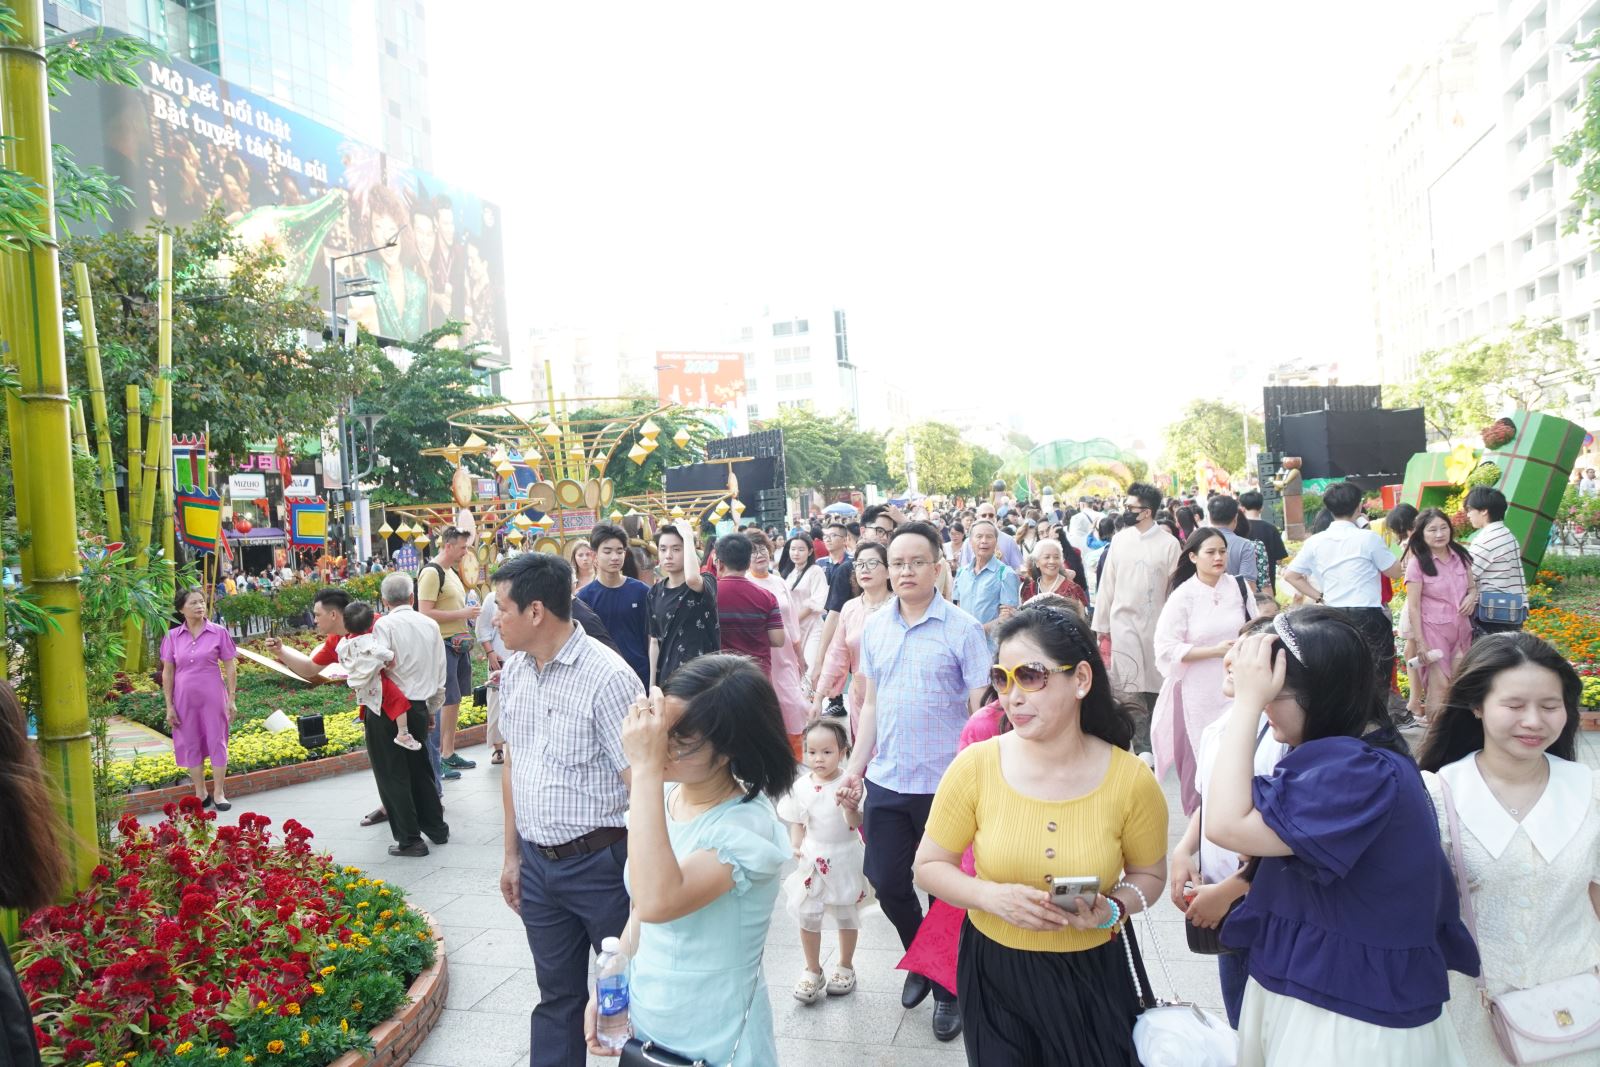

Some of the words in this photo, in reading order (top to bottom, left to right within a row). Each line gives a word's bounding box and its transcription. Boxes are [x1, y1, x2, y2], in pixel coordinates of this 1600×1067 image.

[149, 61, 184, 95] Mở
[187, 77, 220, 111] kết
[222, 99, 254, 126] nối
[256, 111, 292, 143] thật
[152, 94, 190, 130] Bật
[192, 112, 243, 151] tuyệt
[245, 134, 273, 160] tác
[276, 146, 302, 173] bia
